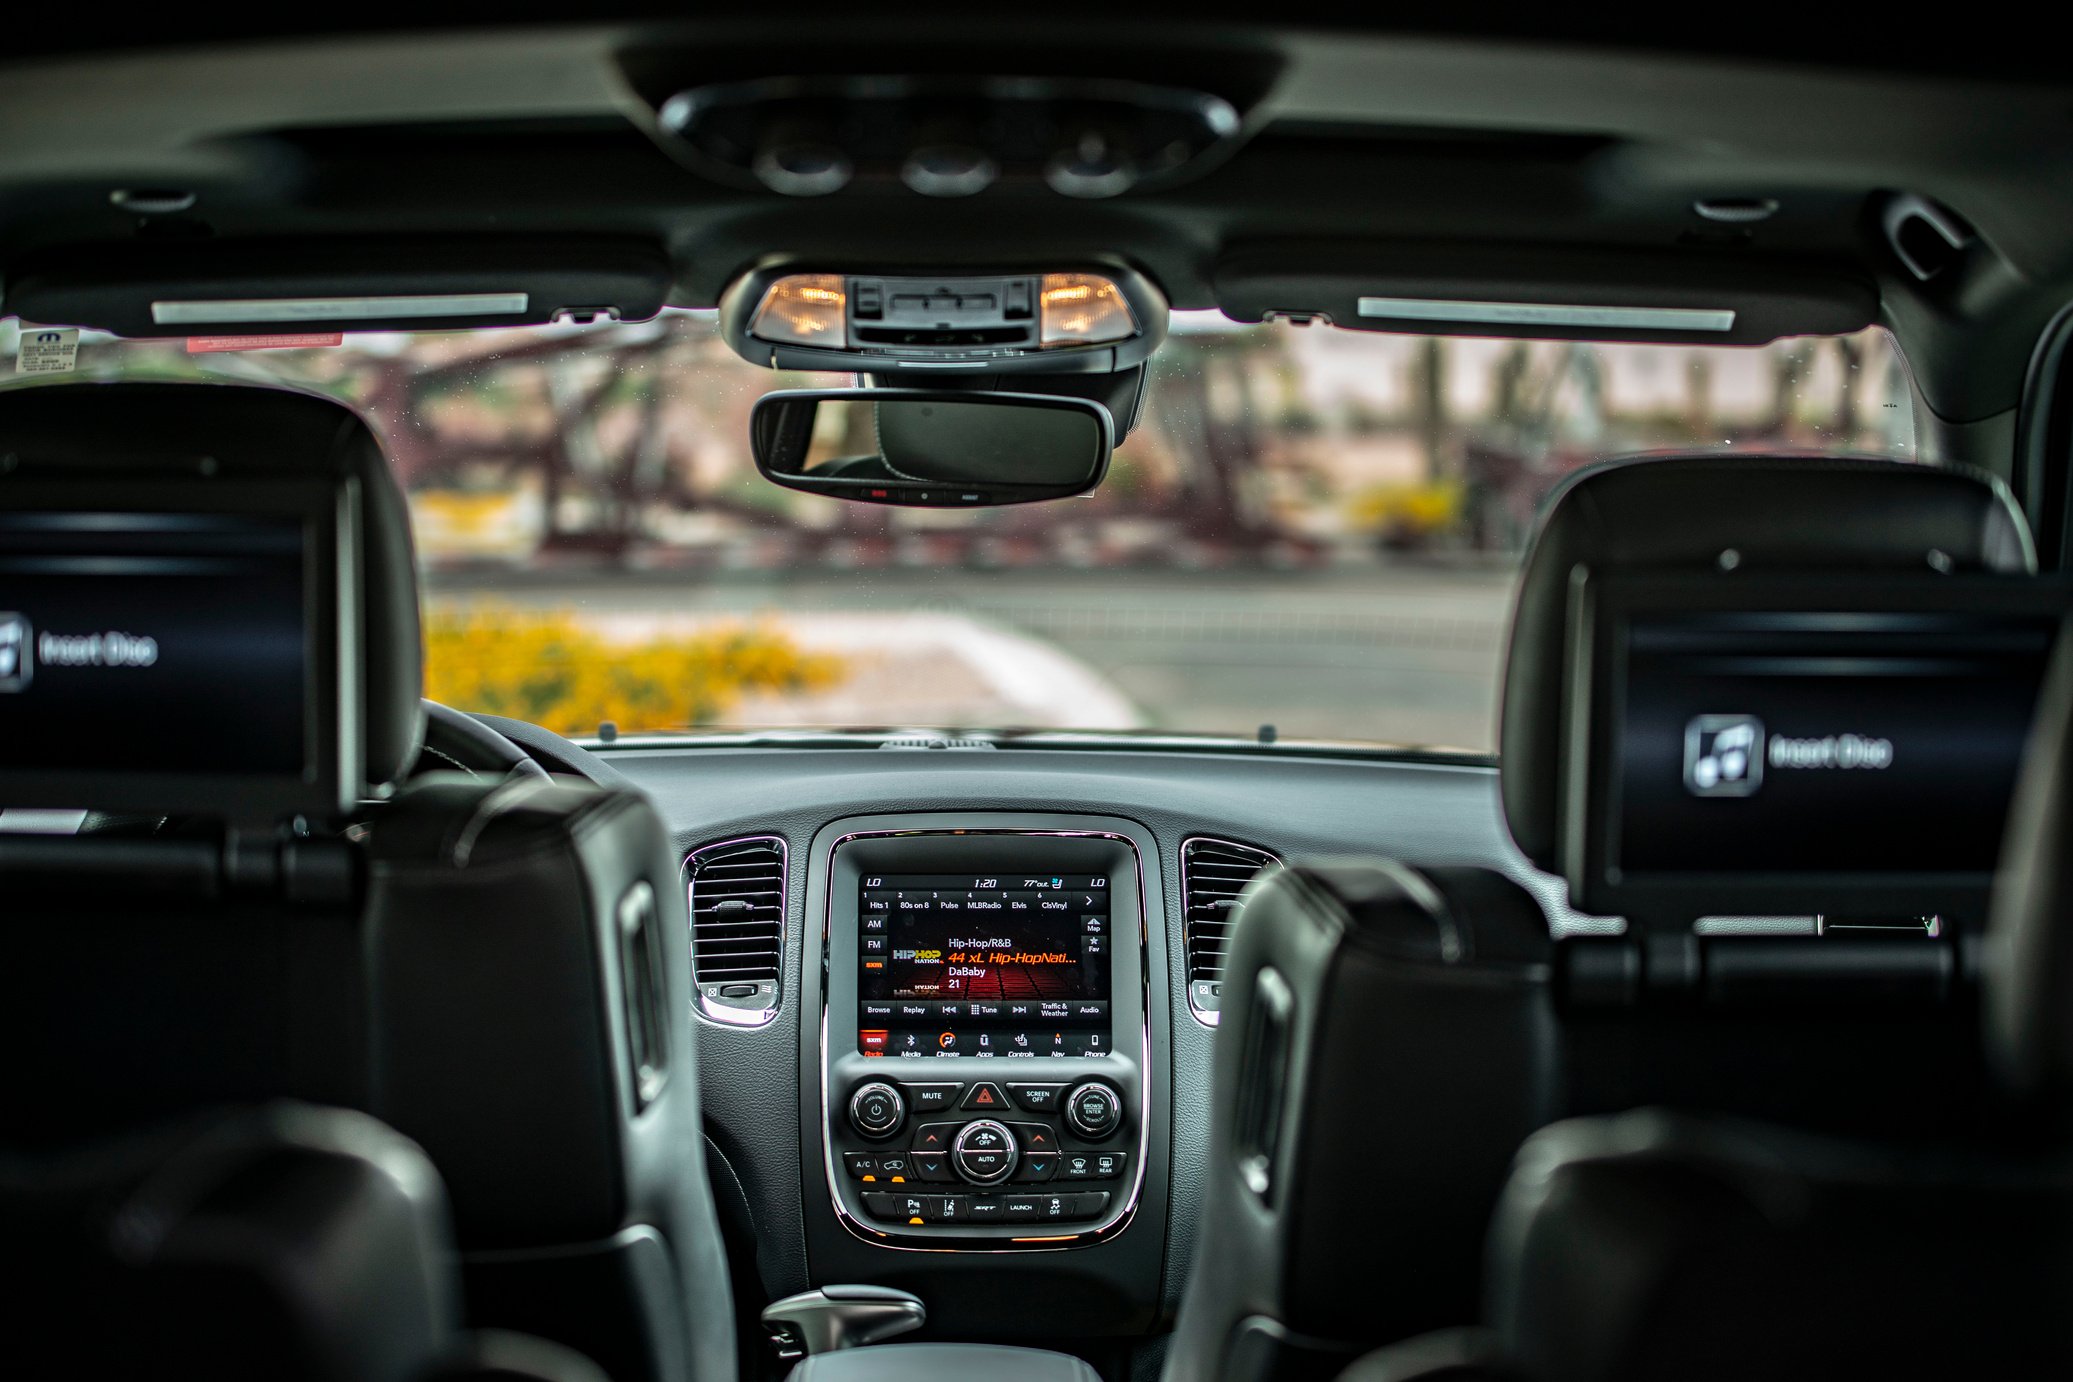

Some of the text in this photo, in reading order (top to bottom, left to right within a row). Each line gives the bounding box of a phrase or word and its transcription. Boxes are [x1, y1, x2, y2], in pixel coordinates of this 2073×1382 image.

[39, 630, 158, 667] Insert Disc
[1768, 733, 1893, 769] Insert Disc
[866, 878, 881, 887] LO
[974, 879, 997, 888] 1:20
[1090, 878, 1105, 887] LO
[869, 901, 883, 909] Hits
[940, 901, 959, 909] Pulse
[967, 901, 1002, 909] MLBRadio
[1011, 901, 1027, 909] Elvis
[1041, 901, 1068, 910] ClsVinyl
[867, 920, 882, 928] AM
[867, 940, 881, 949] FM
[948, 938, 1012, 949] Hip-Hop/R&B
[948, 952, 965, 963] 44
[968, 952, 985, 963] xL
[948, 966, 986, 978] DaBaby
[948, 979, 960, 988] 21
[903, 1006, 926, 1014] Replay
[922, 1092, 942, 1100] MUTE
